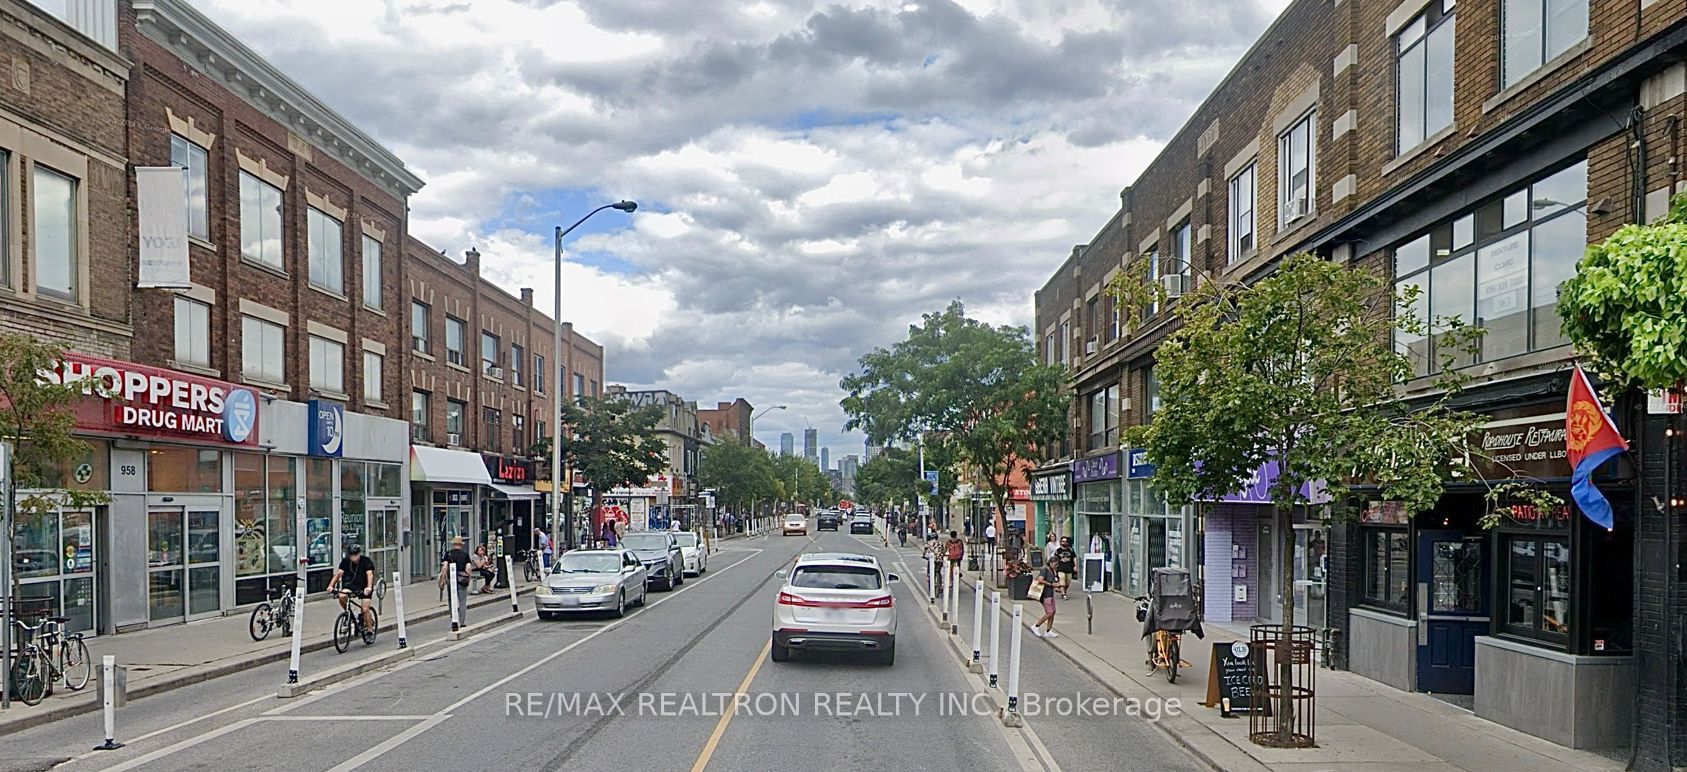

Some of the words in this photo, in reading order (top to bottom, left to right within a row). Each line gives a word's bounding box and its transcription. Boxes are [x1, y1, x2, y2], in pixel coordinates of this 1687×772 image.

[34, 358, 225, 414] SHOPPERS
[123, 406, 177, 429] DRUG
[181, 414, 224, 434] MART
[319, 410, 334, 420] OPEN
[327, 425, 334, 437] 10
[1525, 451, 1547, 461] UNDER
[1549, 450, 1567, 459] LLBO
[121, 465, 136, 476] 958
[1512, 505, 1536, 520] PATIO
[1224, 675, 1241, 685] ICE
[1231, 687, 1255, 698] BEE
